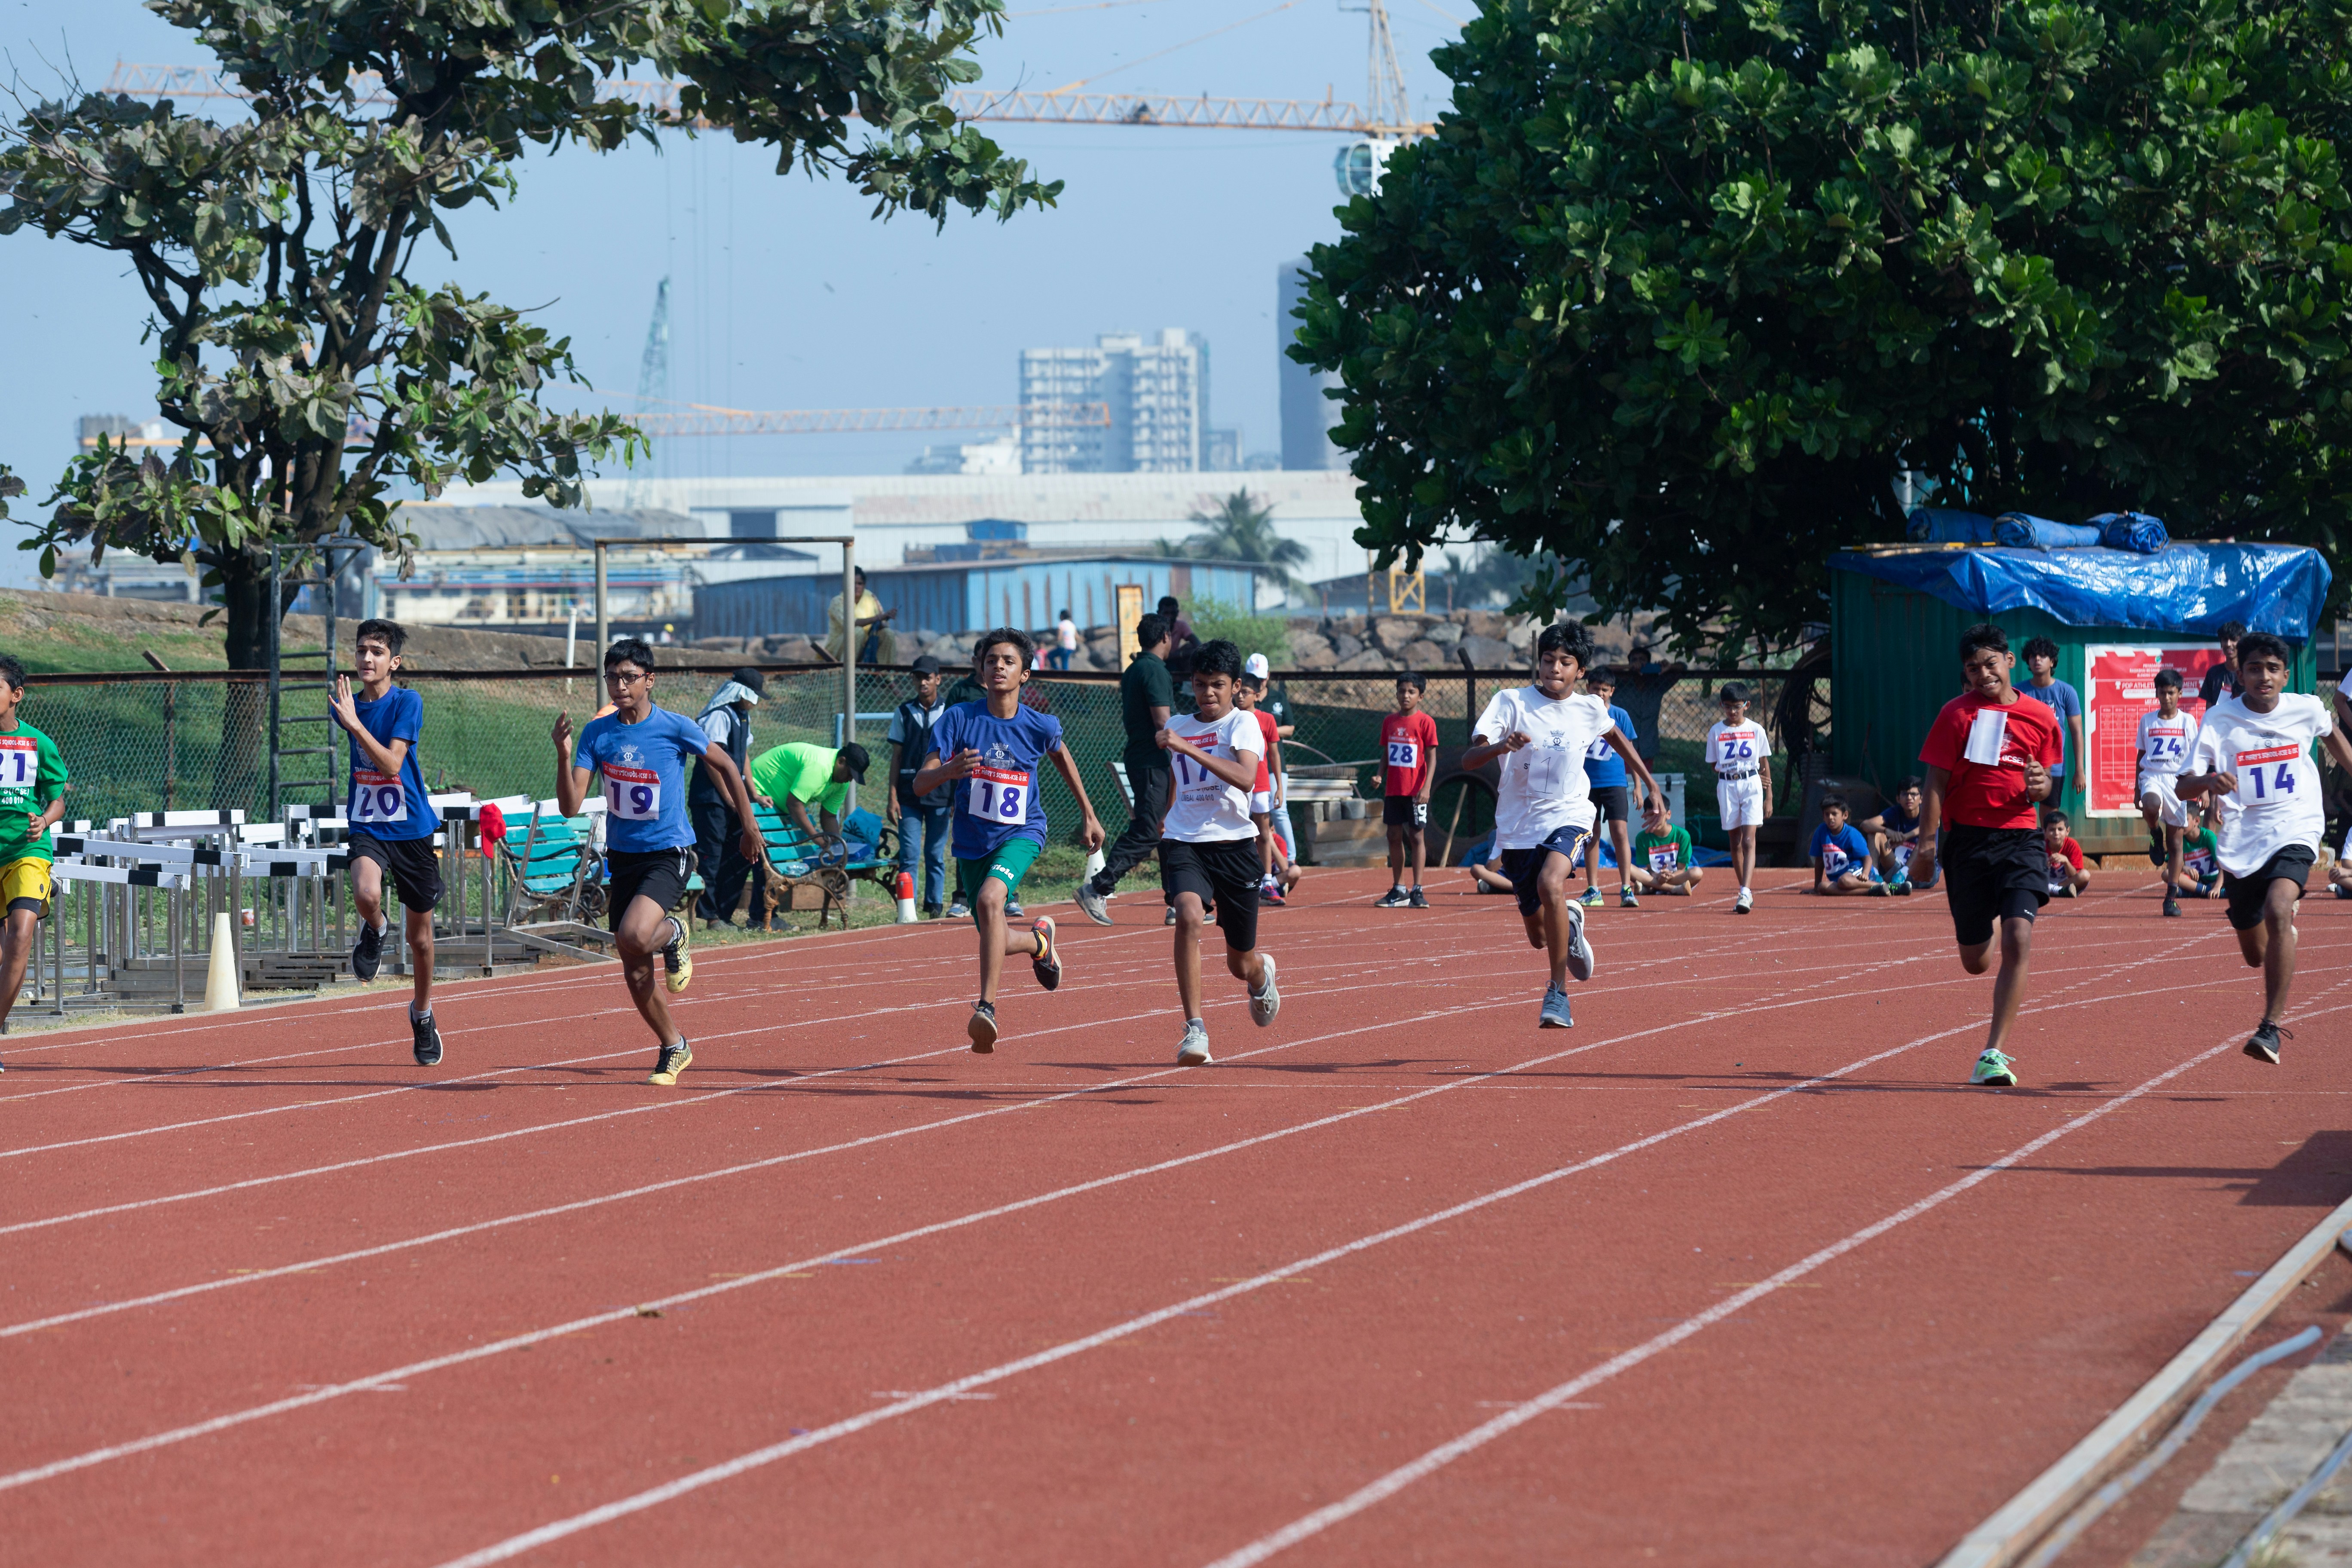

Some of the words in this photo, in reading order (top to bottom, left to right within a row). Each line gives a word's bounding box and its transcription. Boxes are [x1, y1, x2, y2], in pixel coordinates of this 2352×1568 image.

[1389, 744, 1413, 763] 28
[1724, 741, 1752, 760] 26
[2152, 738, 2181, 756] 24
[622, 771, 648, 779] SCHOOL-ICSE
[996, 772, 1018, 781] SCHOOL-ICSE
[1177, 749, 1213, 785] 17
[1534, 756, 1577, 795] 16
[2250, 763, 2294, 799] 14
[358, 786, 400, 816] 20
[611, 780, 653, 814] 19
[982, 782, 1020, 817] 18
[1825, 853, 1844, 871] 34
